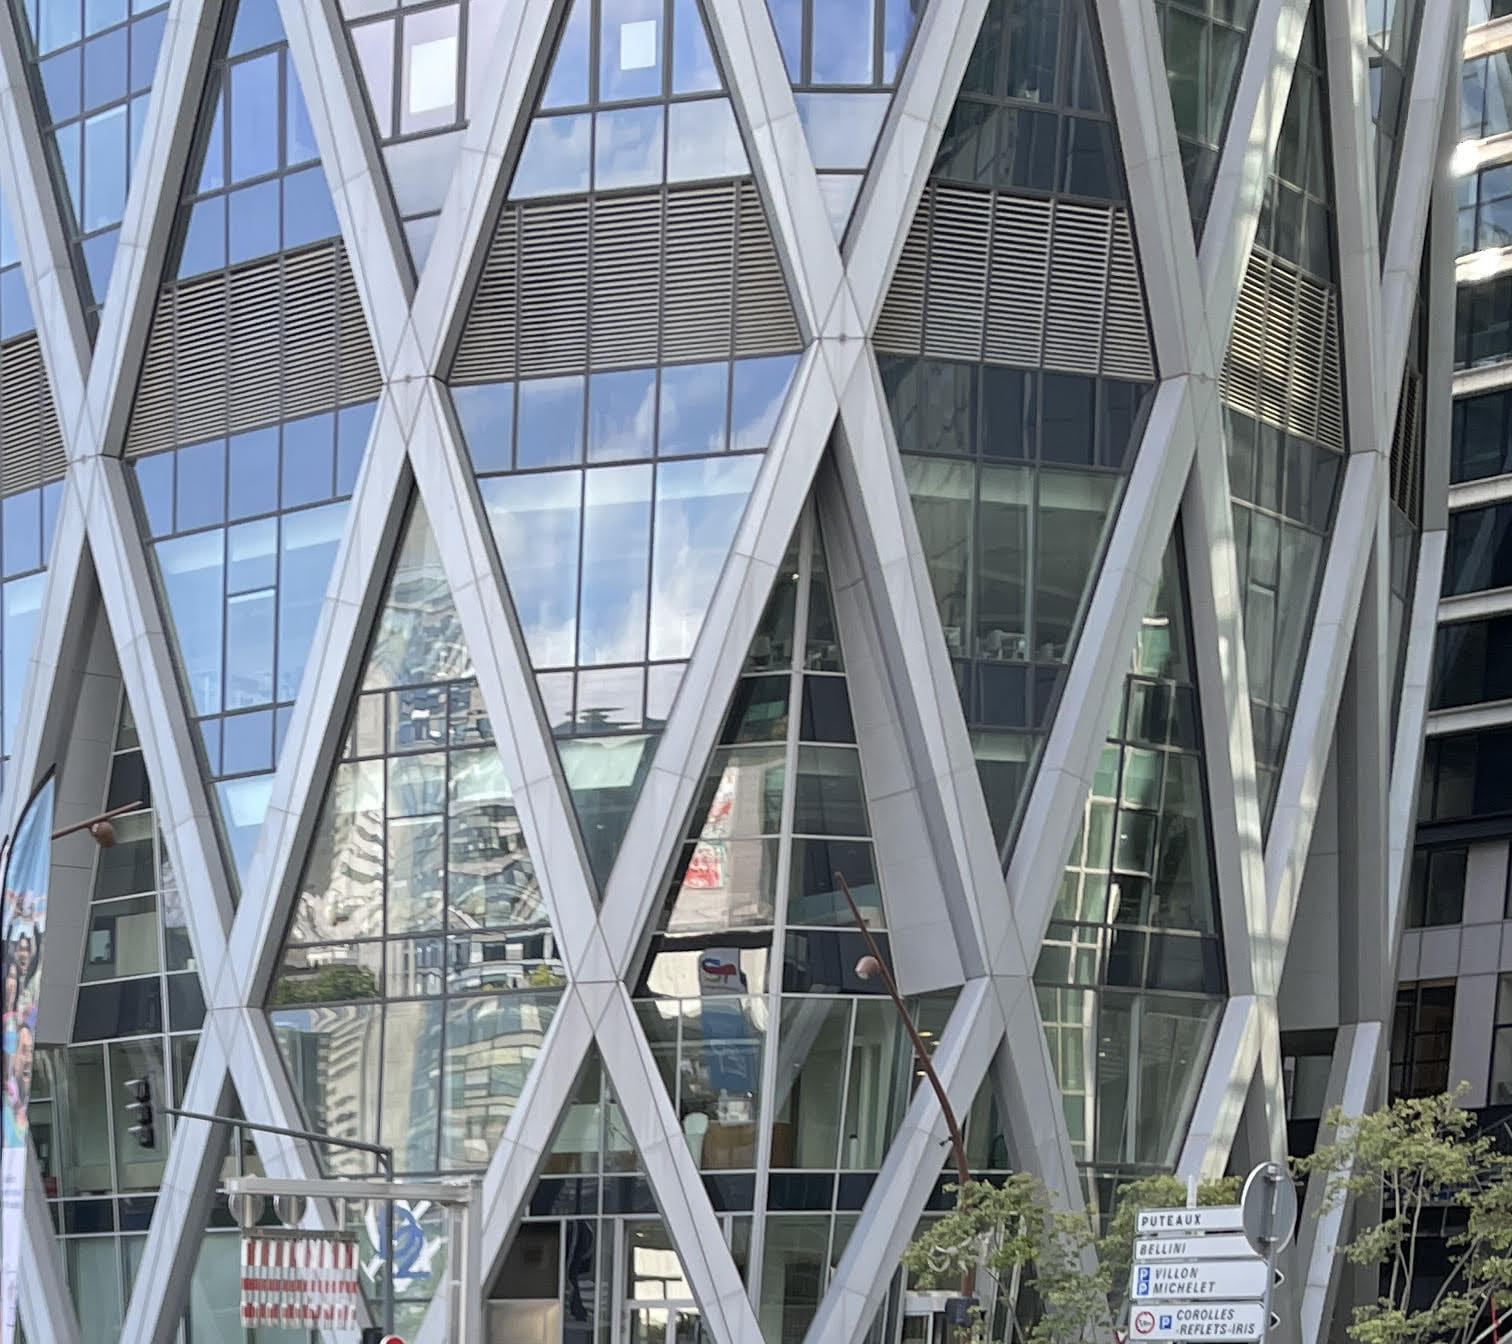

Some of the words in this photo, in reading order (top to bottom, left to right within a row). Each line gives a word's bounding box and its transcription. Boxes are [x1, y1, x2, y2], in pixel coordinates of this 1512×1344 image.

[1141, 1213, 1202, 1227] PUTEAUX
[1139, 1242, 1186, 1255] BELLINI
[1154, 1267, 1199, 1279] VILLON
[1152, 1281, 1216, 1294] MICHELET
[1176, 1308, 1235, 1321] COROLLES
